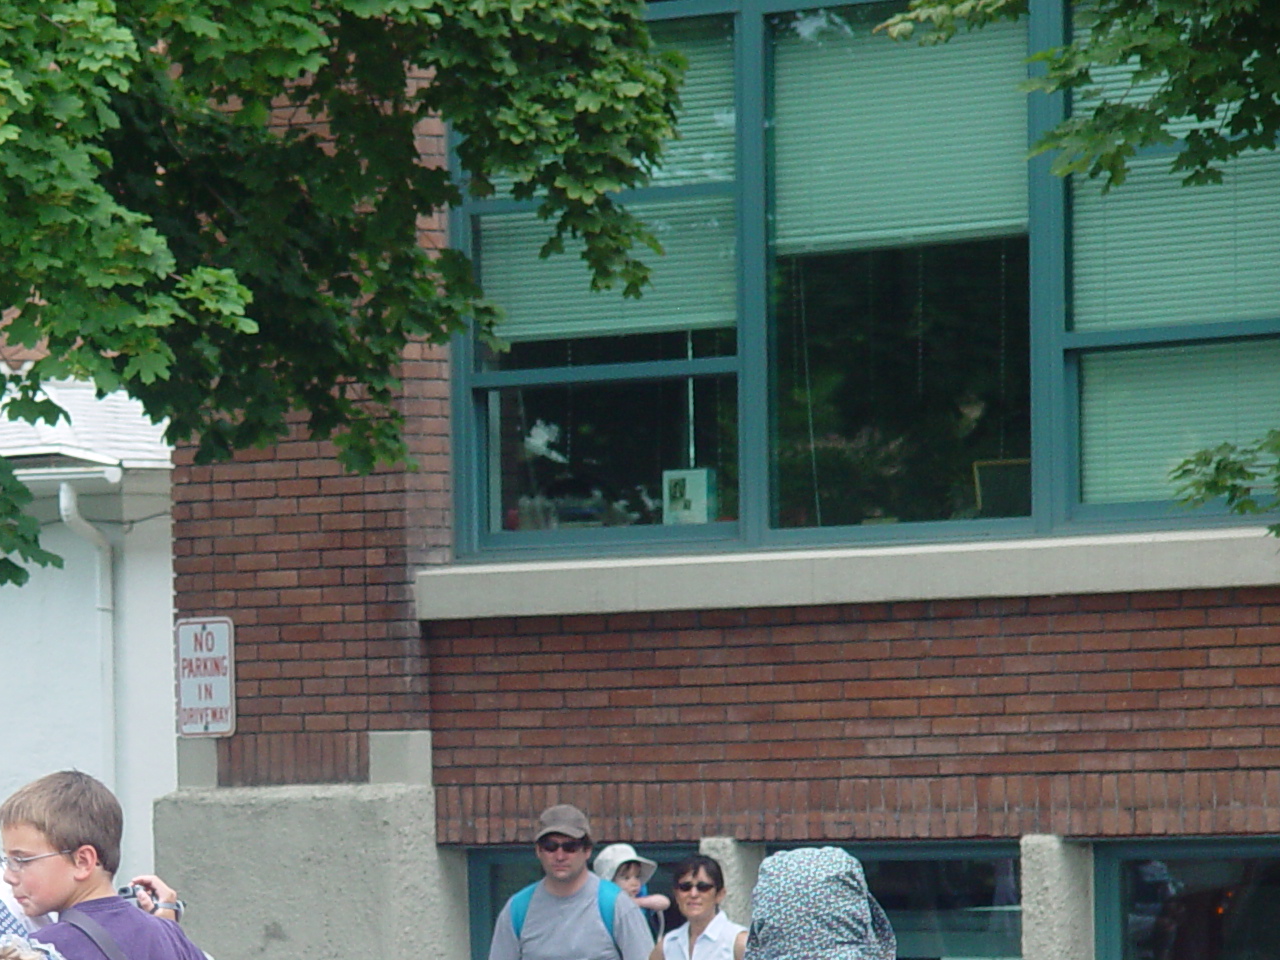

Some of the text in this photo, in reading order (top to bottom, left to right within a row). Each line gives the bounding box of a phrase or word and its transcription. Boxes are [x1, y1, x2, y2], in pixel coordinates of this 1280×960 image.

[193, 631, 215, 652] NO
[181, 656, 227, 678] PARKING
[198, 683, 213, 701] IN
